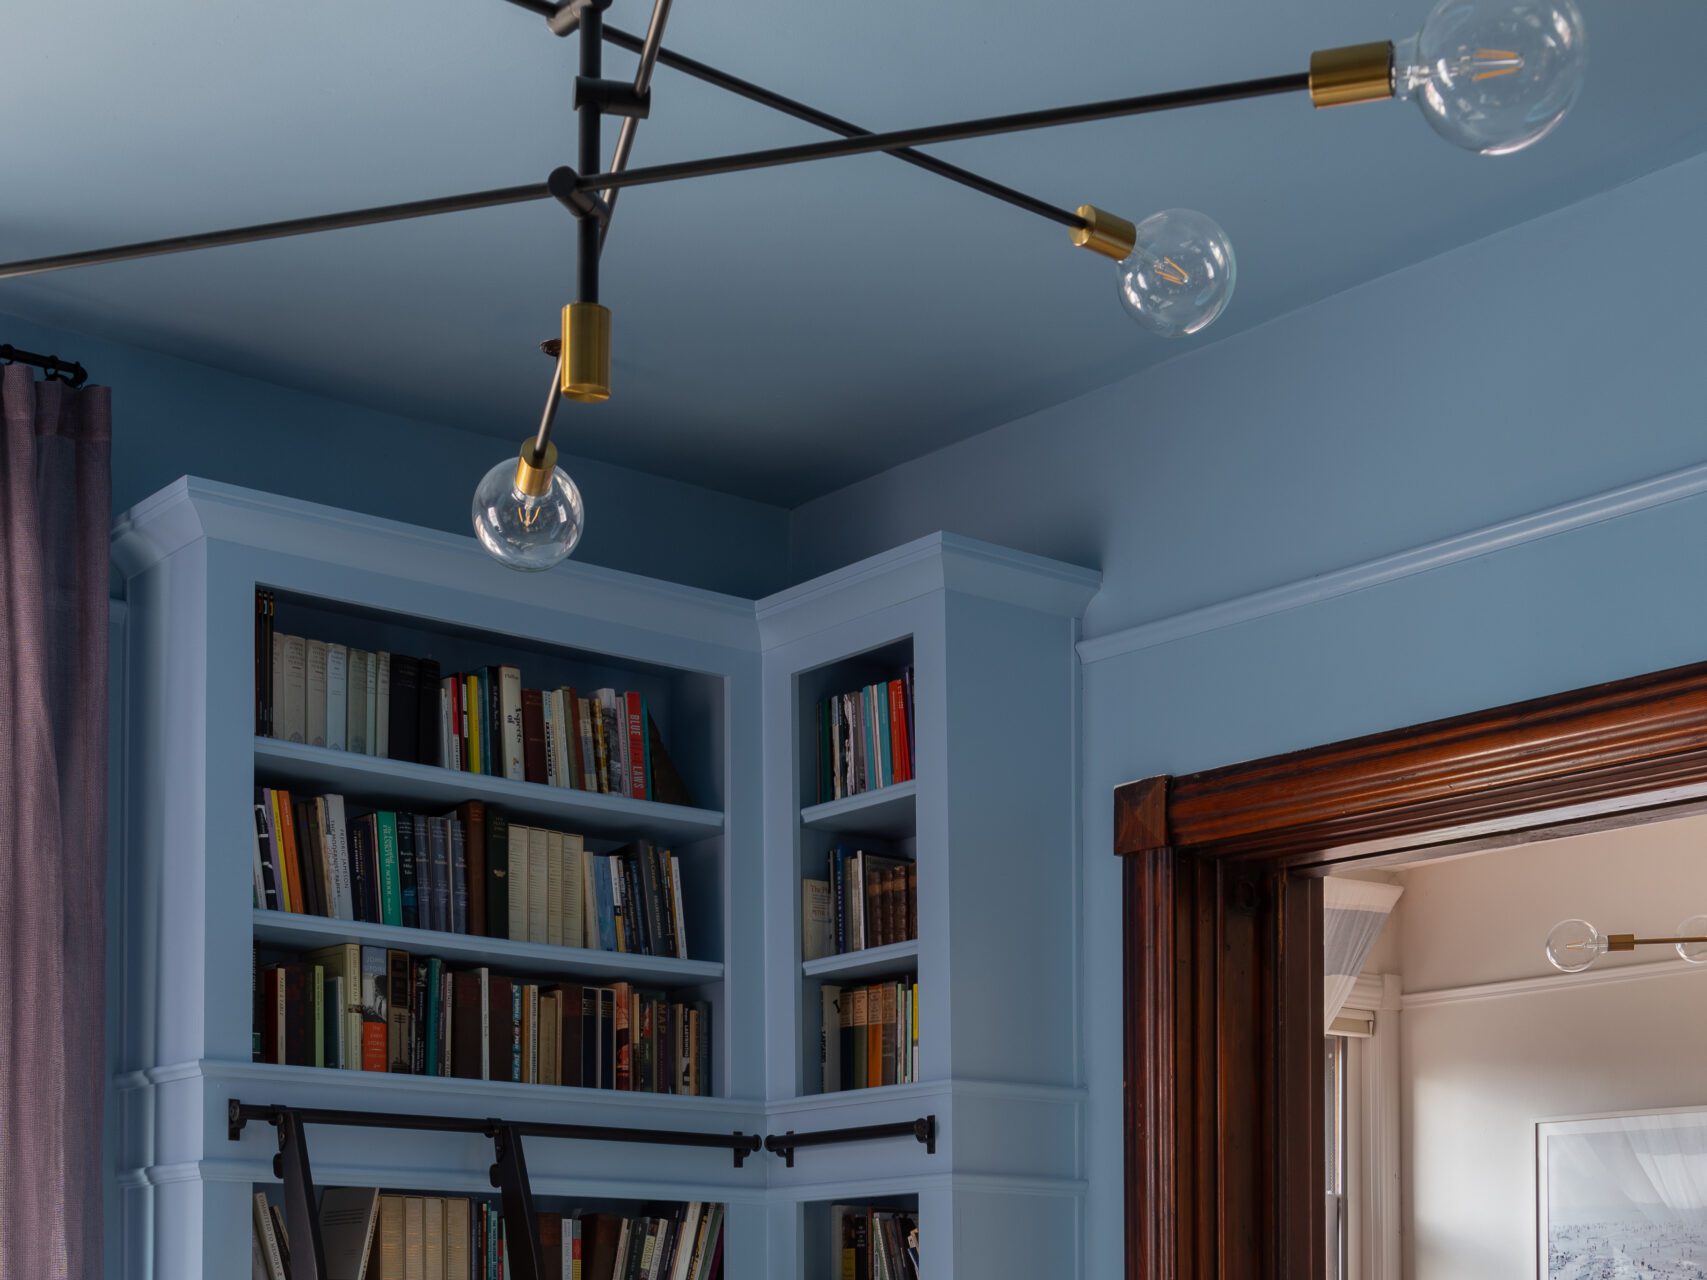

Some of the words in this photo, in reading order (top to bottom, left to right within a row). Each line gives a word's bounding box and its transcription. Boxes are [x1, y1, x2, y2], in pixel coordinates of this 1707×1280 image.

[630, 714, 641, 736] BLUE
[633, 766, 644, 789] LAWS
[341, 859, 349, 888] JAMESON
[657, 1003, 667, 1033] MAP
[258, 1195, 273, 1232] COMMITTED
[269, 1243, 280, 1270] MEMORY
